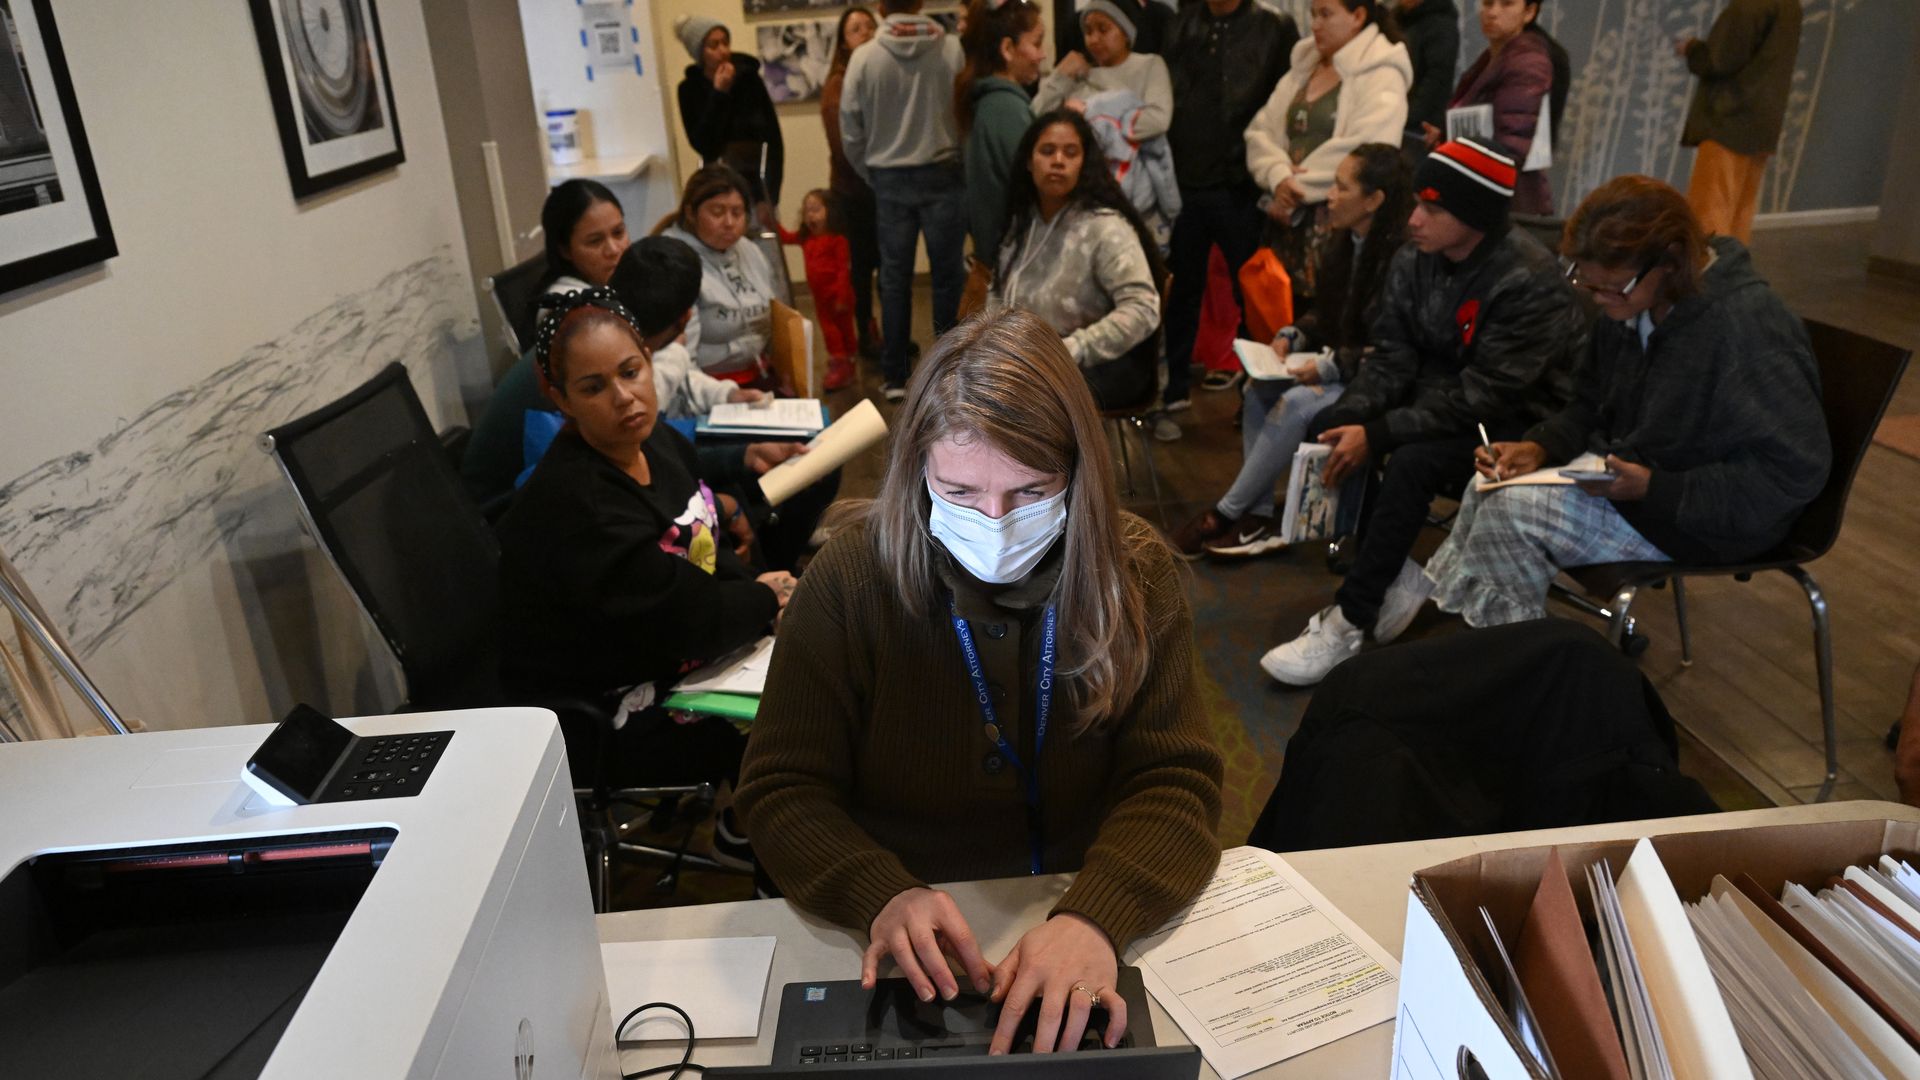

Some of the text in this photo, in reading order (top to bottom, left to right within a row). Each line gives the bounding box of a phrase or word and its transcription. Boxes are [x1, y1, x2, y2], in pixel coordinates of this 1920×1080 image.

[956, 619, 988, 704] CITY ATTORNEY'S
[1040, 665, 1051, 690] CITY
[1037, 694, 1049, 736] DENVER
